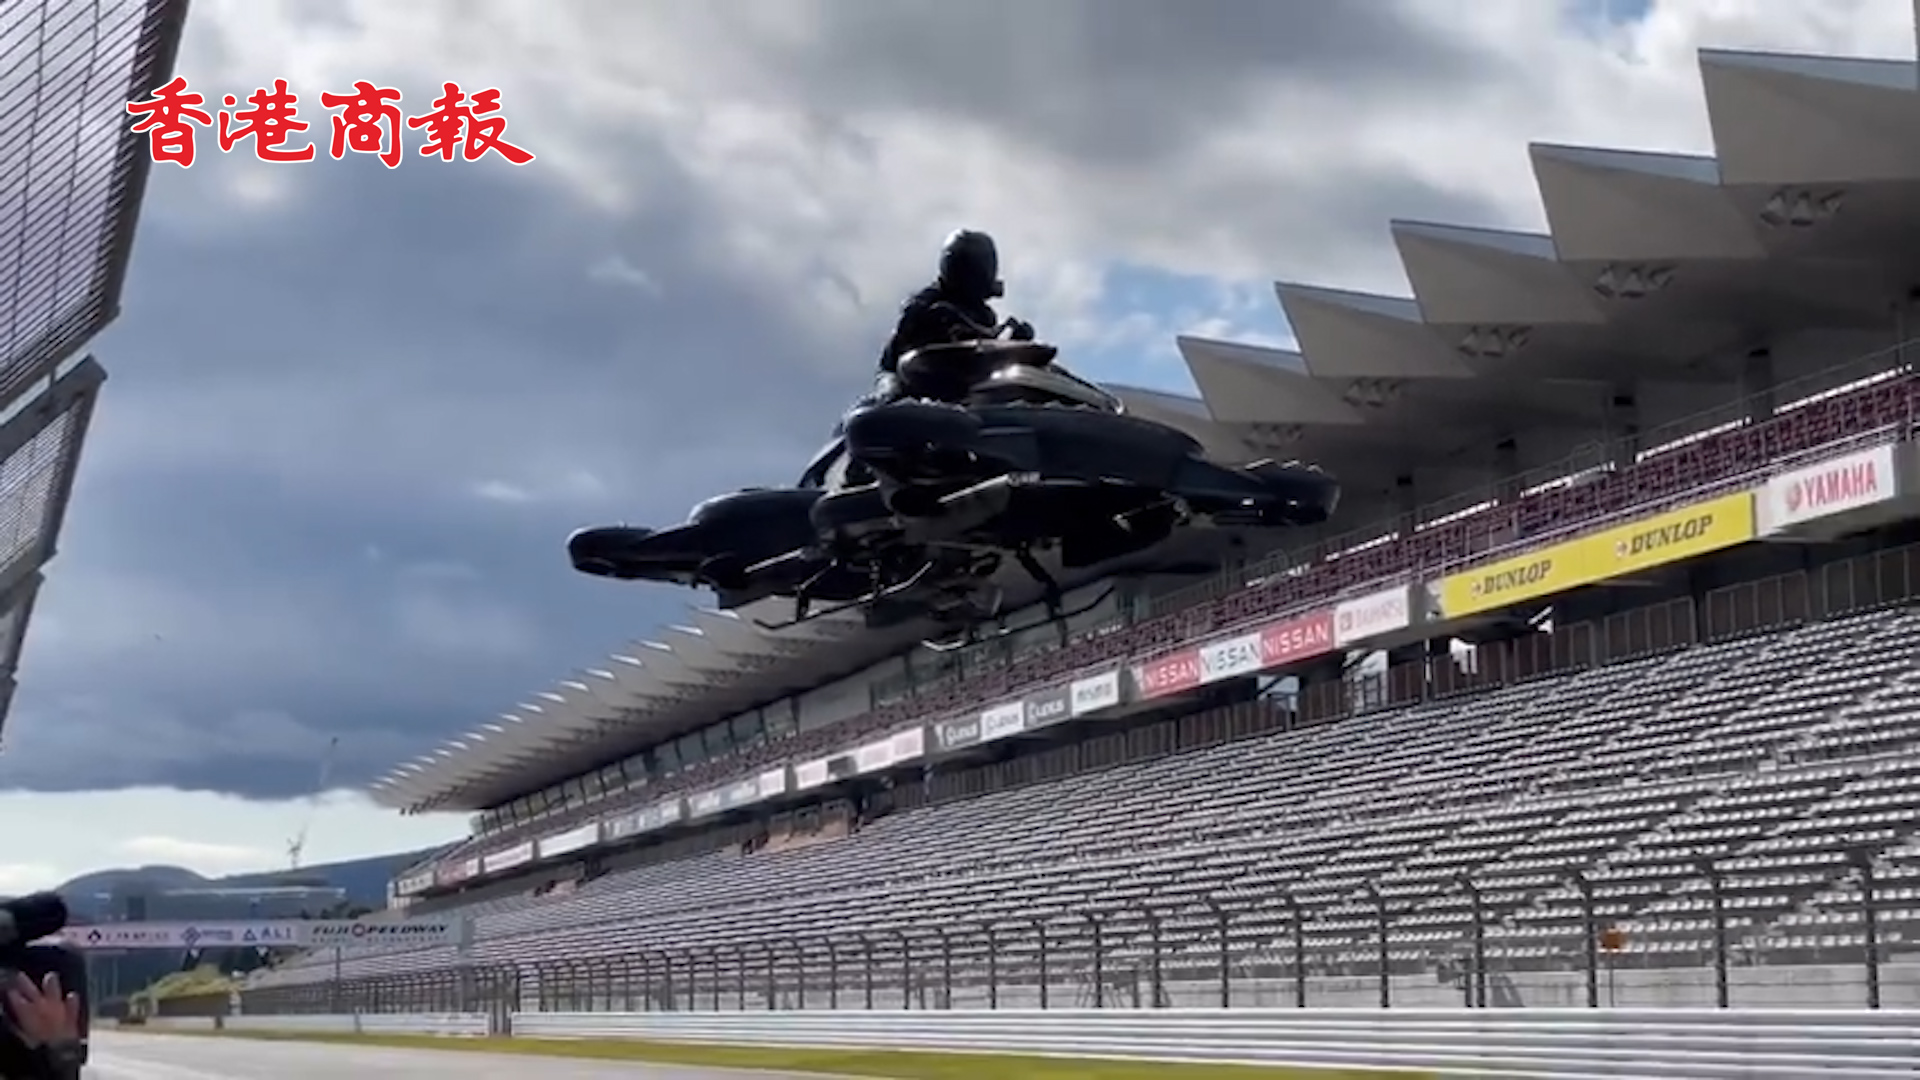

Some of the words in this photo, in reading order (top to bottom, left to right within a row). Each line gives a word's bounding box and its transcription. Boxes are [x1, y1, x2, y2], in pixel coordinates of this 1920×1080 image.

[1802, 460, 1878, 507] YAMAHA
[1629, 515, 1713, 556] DUNLOP
[1482, 559, 1552, 595] DUNLOP
[1263, 622, 1329, 656] NISSAN
[1145, 659, 1198, 688] NISSAN
[1202, 642, 1259, 673] NISSAN
